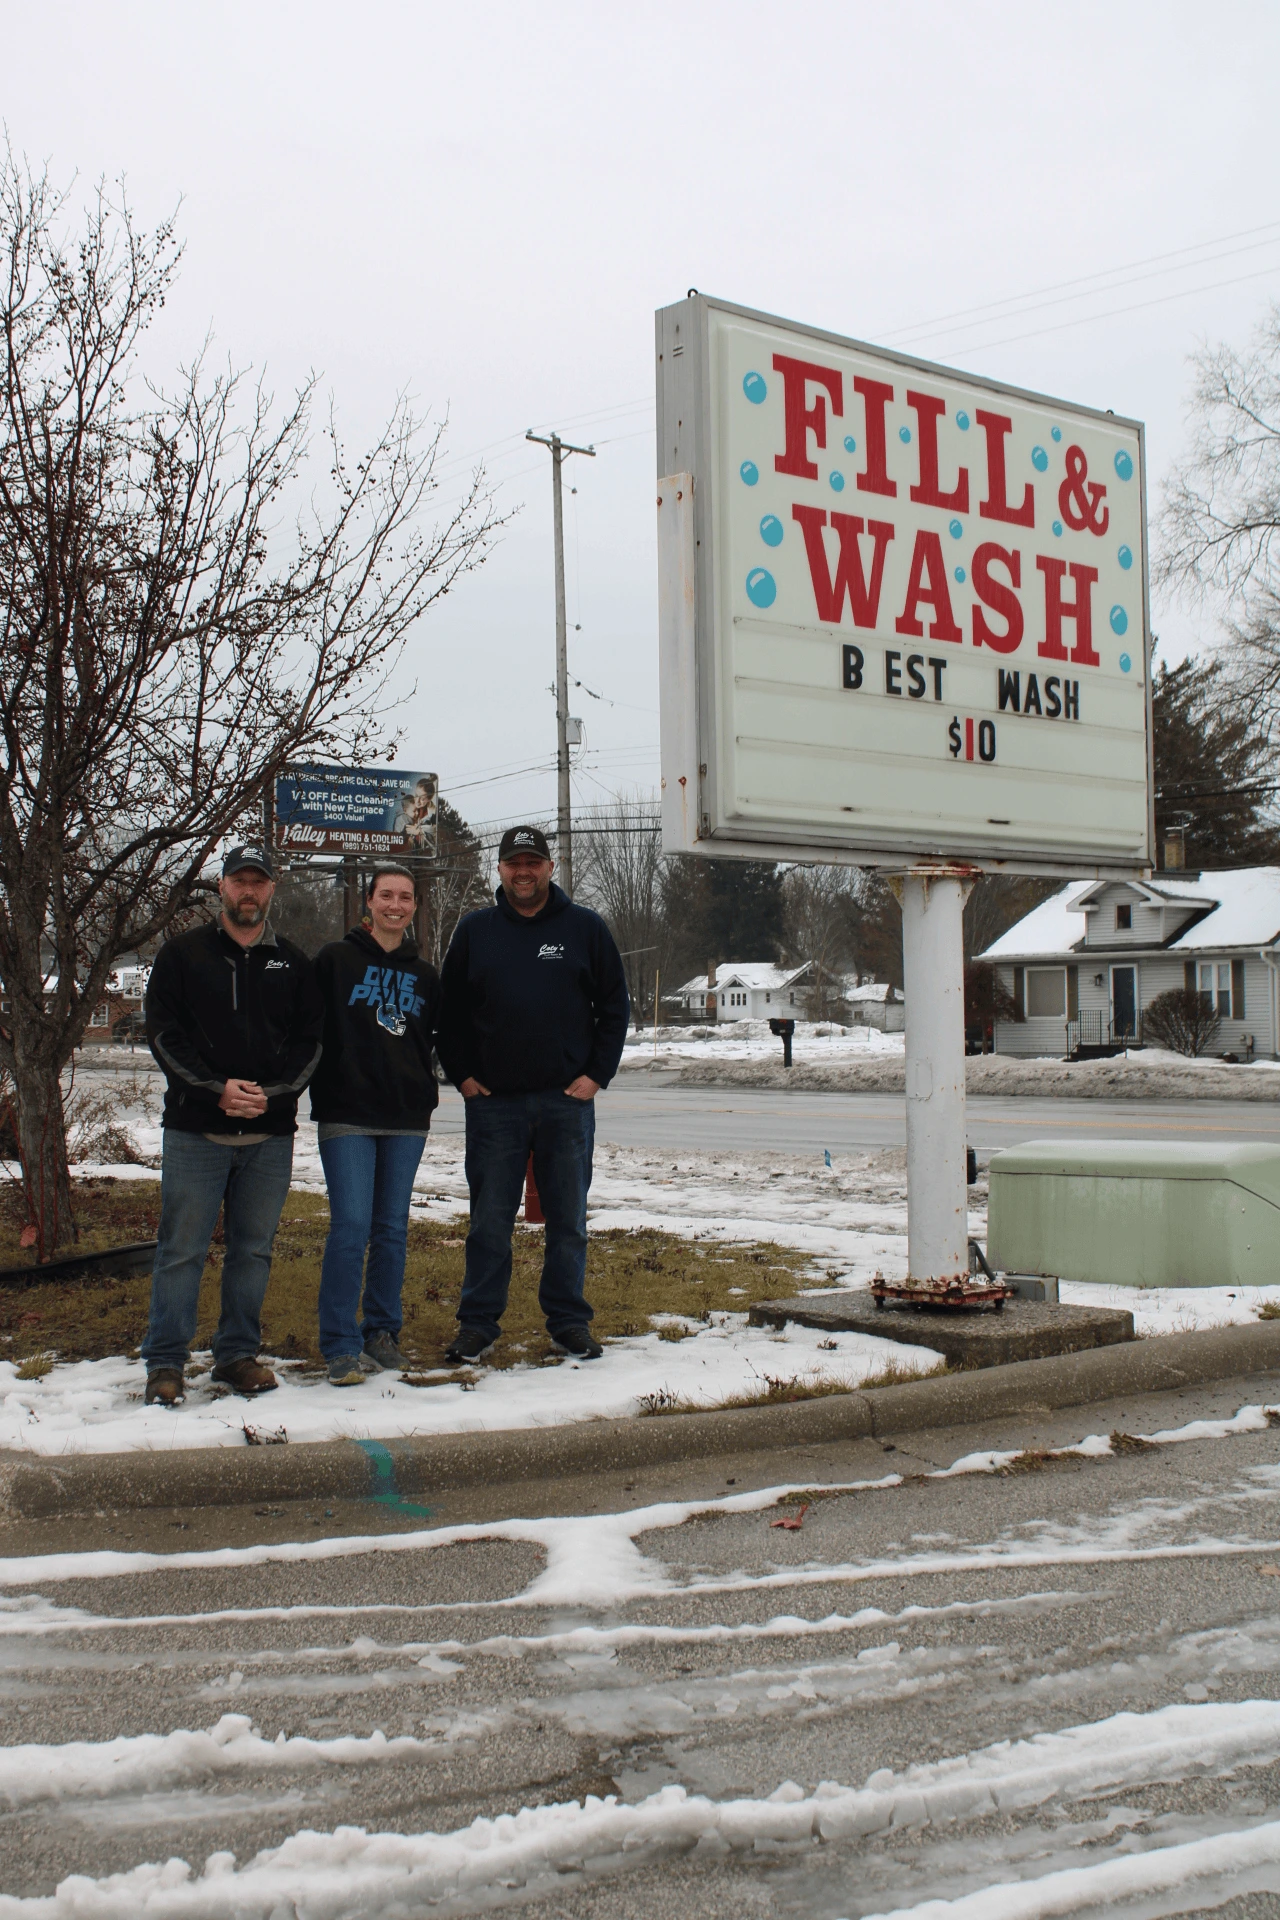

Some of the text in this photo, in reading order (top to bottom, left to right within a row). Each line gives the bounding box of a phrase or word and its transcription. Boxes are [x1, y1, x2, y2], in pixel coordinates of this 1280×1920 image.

[772, 353, 1109, 537] FILL &
[792, 503, 1100, 667] WASH
[998, 668, 1080, 720] WASH
[948, 716, 997, 763] $10
[302, 801, 384, 815] with New Furnace
[308, 791, 329, 801] OFF
[331, 792, 353, 803] Duct
[354, 794, 395, 807] Cleaning
[323, 812, 365, 822] $400 Value!
[280, 823, 404, 848] Valley HEATING & COOLING
[361, 843, 390, 852] 751-1624
[537, 943, 565, 958] Coty's
[124, 986, 142, 997] 45
[363, 965, 418, 993] ONE
[347, 984, 426, 1017] PRIDE
